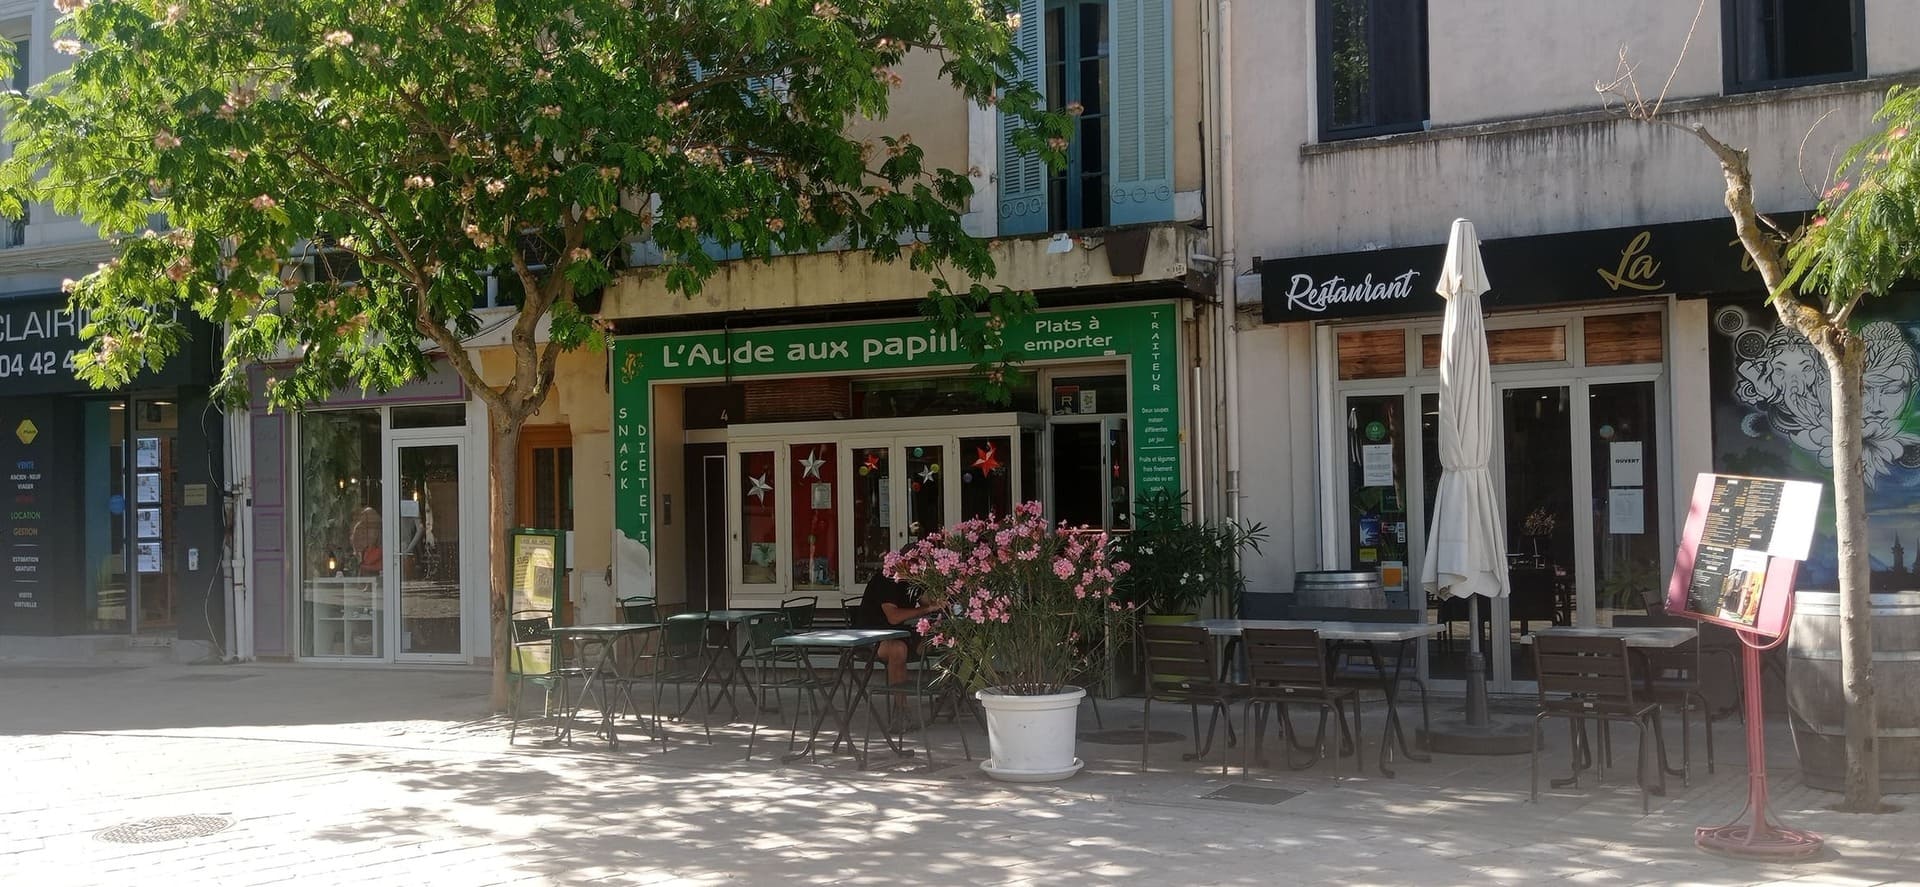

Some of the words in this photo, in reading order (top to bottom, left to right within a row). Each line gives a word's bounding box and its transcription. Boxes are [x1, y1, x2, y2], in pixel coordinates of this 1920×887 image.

[1597, 230, 1666, 291] La
[1285, 268, 1421, 312] Restaurant
[1035, 319, 1082, 334] Plats
[1088, 315, 1100, 330] à
[663, 339, 775, 369] L'Aude
[787, 339, 849, 361] aux
[863, 327, 1004, 363] papill
[1024, 335, 1113, 353] emporter
[1151, 311, 1161, 392] TRAITEUR
[30, 351, 57, 375] 42
[720, 409, 729, 422] 4
[618, 407, 629, 490] SNACK
[10, 511, 41, 521] LOCATION
[13, 527, 38, 537] GESTION
